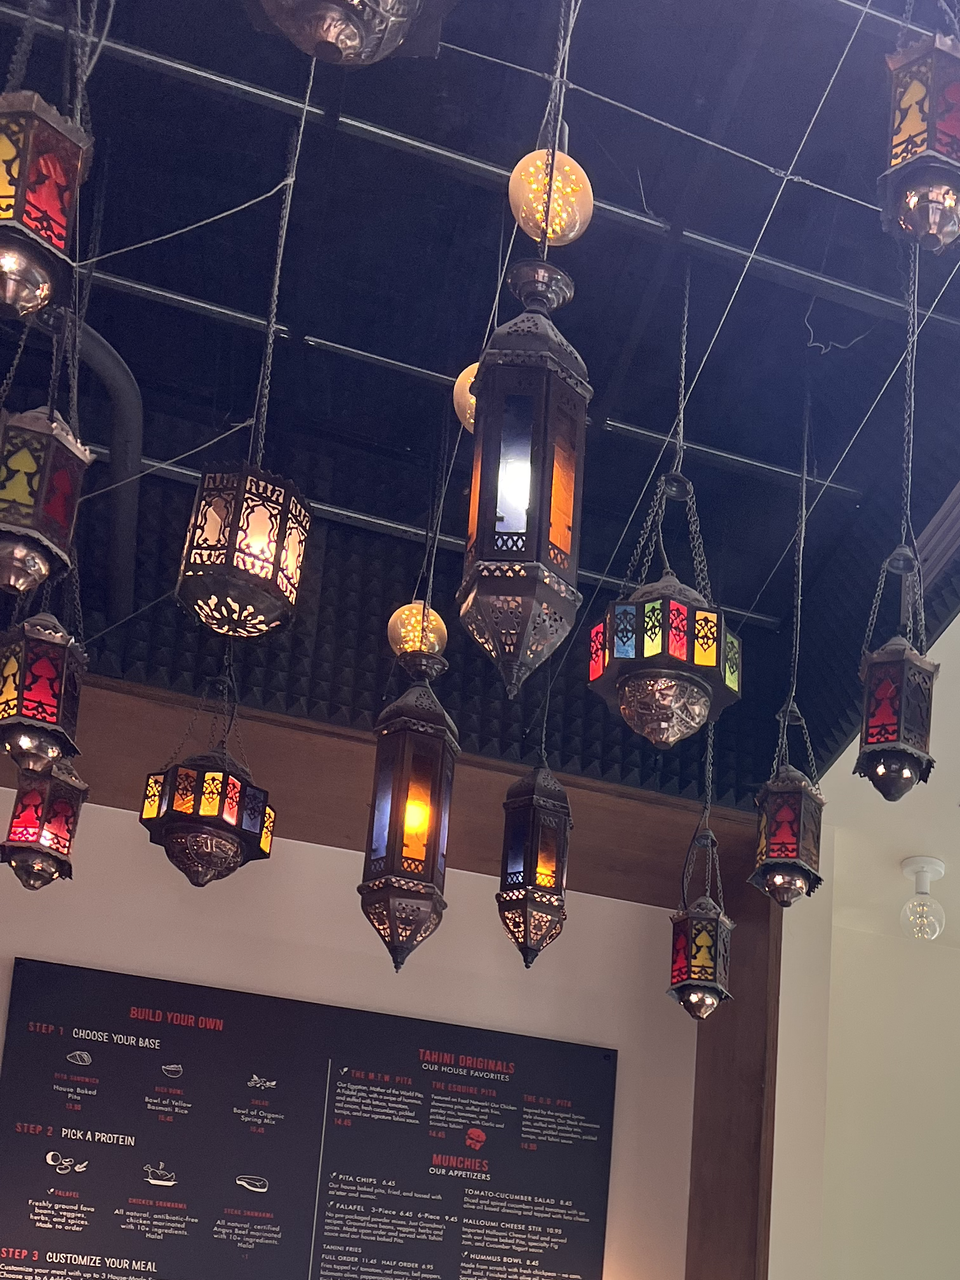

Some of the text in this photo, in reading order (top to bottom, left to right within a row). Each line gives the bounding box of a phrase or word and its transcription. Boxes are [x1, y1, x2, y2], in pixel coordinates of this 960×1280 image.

[129, 1006, 223, 1031] BUILD YOUR OWN
[28, 1021, 63, 1035] STEP 1
[72, 1028, 160, 1049] CHOOSE YOUR BASE
[419, 1048, 514, 1073] TAHINI ORIGINALS
[421, 1062, 509, 1081] OUR HOUSE FAVORITES
[53, 1084, 96, 1095] House Baked
[432, 1080, 496, 1097] THE ESQUIRE PITA
[146, 1103, 188, 1114] Basmati Rice
[171, 1099, 191, 1107] Yellow
[240, 1114, 262, 1124] Spring
[258, 1110, 284, 1119] Organic
[15, 1122, 53, 1136] STEP 2
[61, 1127, 135, 1146] PICK A PROTEIN
[432, 1153, 488, 1171] MUNCHIES
[355, 1176, 376, 1184] CHIPS
[428, 1166, 490, 1180] OUR APPETIZERS
[464, 1188, 532, 1201] TOMATO-CUCUMBER
[534, 1196, 555, 1204] SALAD
[335, 1203, 364, 1211] FALAFEL
[371, 1206, 396, 1215] 3-Piece
[417, 1212, 440, 1220] 6-Piece
[462, 1217, 498, 1226] HALLOUMI
[500, 1222, 525, 1230] CHEESE
[0, 1247, 38, 1260] STEP 3
[469, 1253, 501, 1261] HUMMUS
[502, 1256, 522, 1264] BOWL
[0, 1263, 33, 1272] Customize
[46, 1251, 156, 1272] CUSTOMIZE YOUR MEAL
[0, 1270, 23, 1279] Choose
[34, 1273, 41, 1280] to
